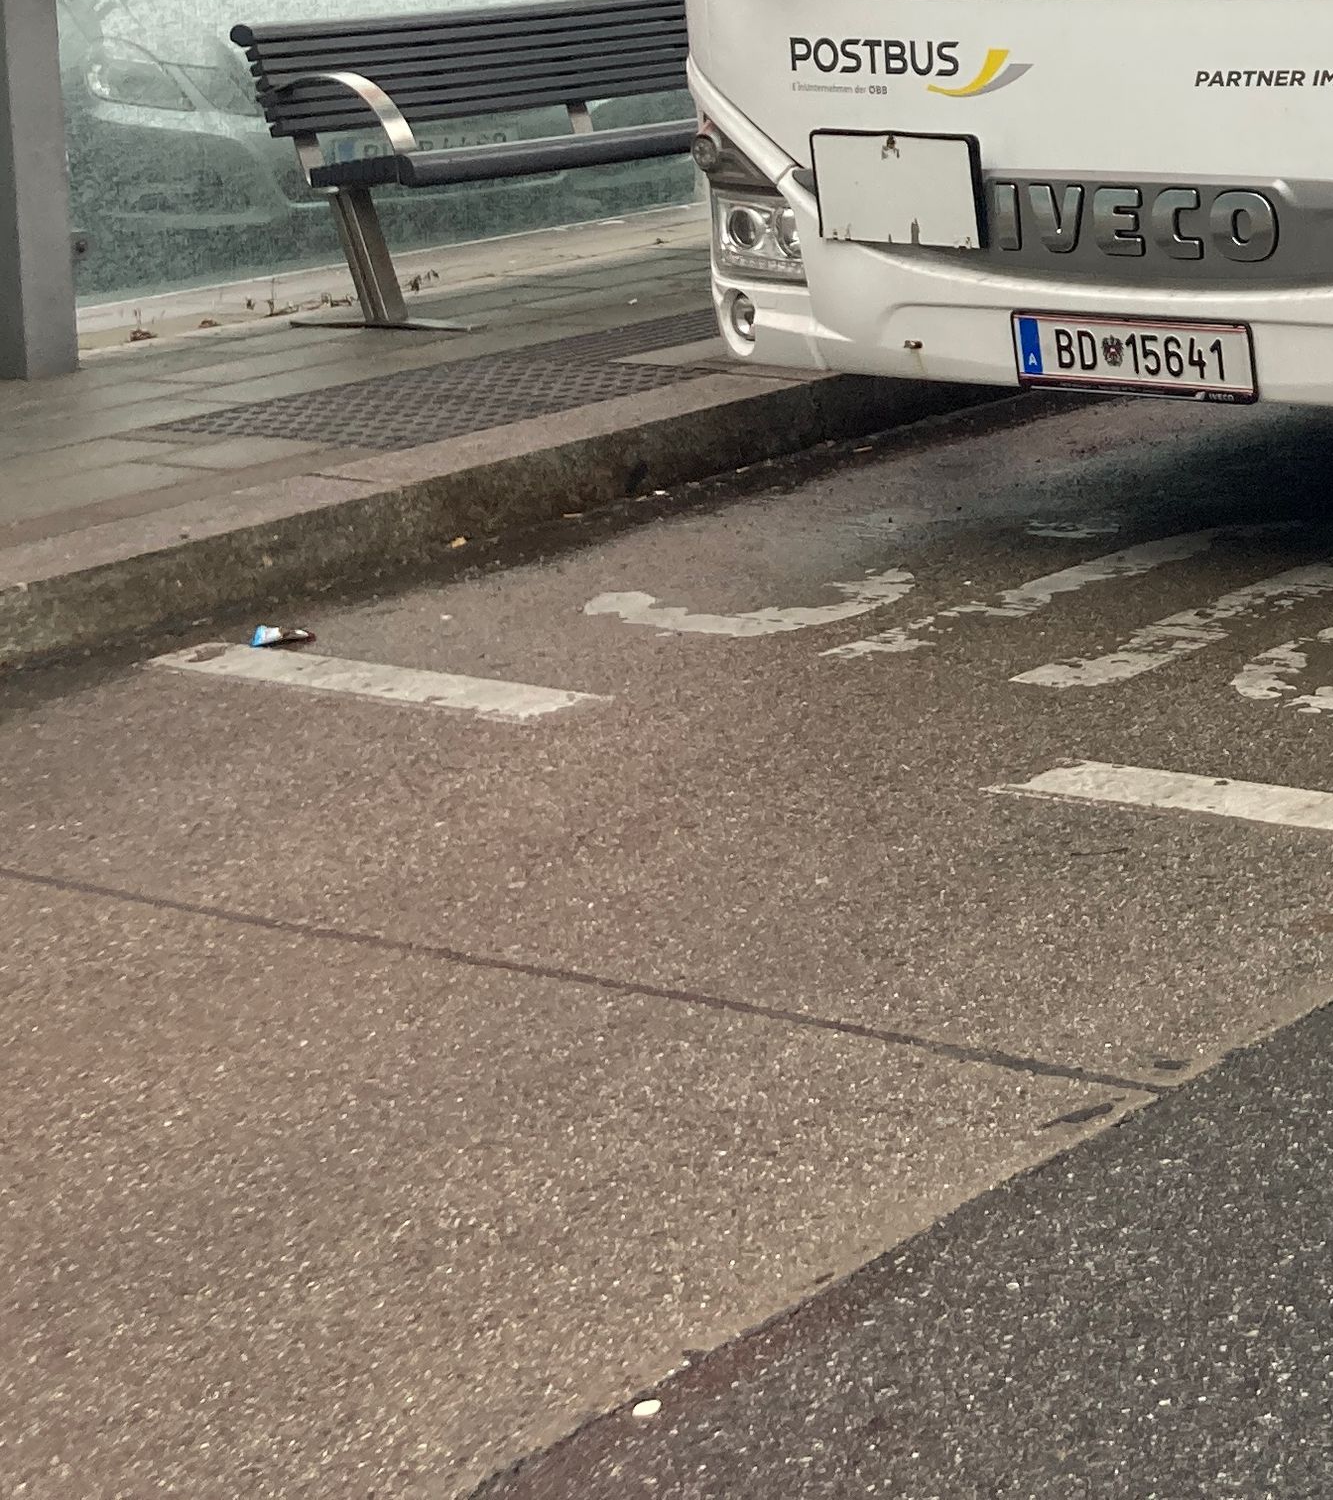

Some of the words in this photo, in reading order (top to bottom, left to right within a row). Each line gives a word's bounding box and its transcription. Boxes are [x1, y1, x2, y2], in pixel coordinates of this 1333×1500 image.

[789, 37, 959, 77] POSTBUS
[1195, 70, 1305, 87] PARTNER
[994, 183, 1280, 263] IVECO
[1028, 352, 1038, 366] A
[1054, 328, 1098, 370] BD
[1125, 332, 1225, 382] 15641
